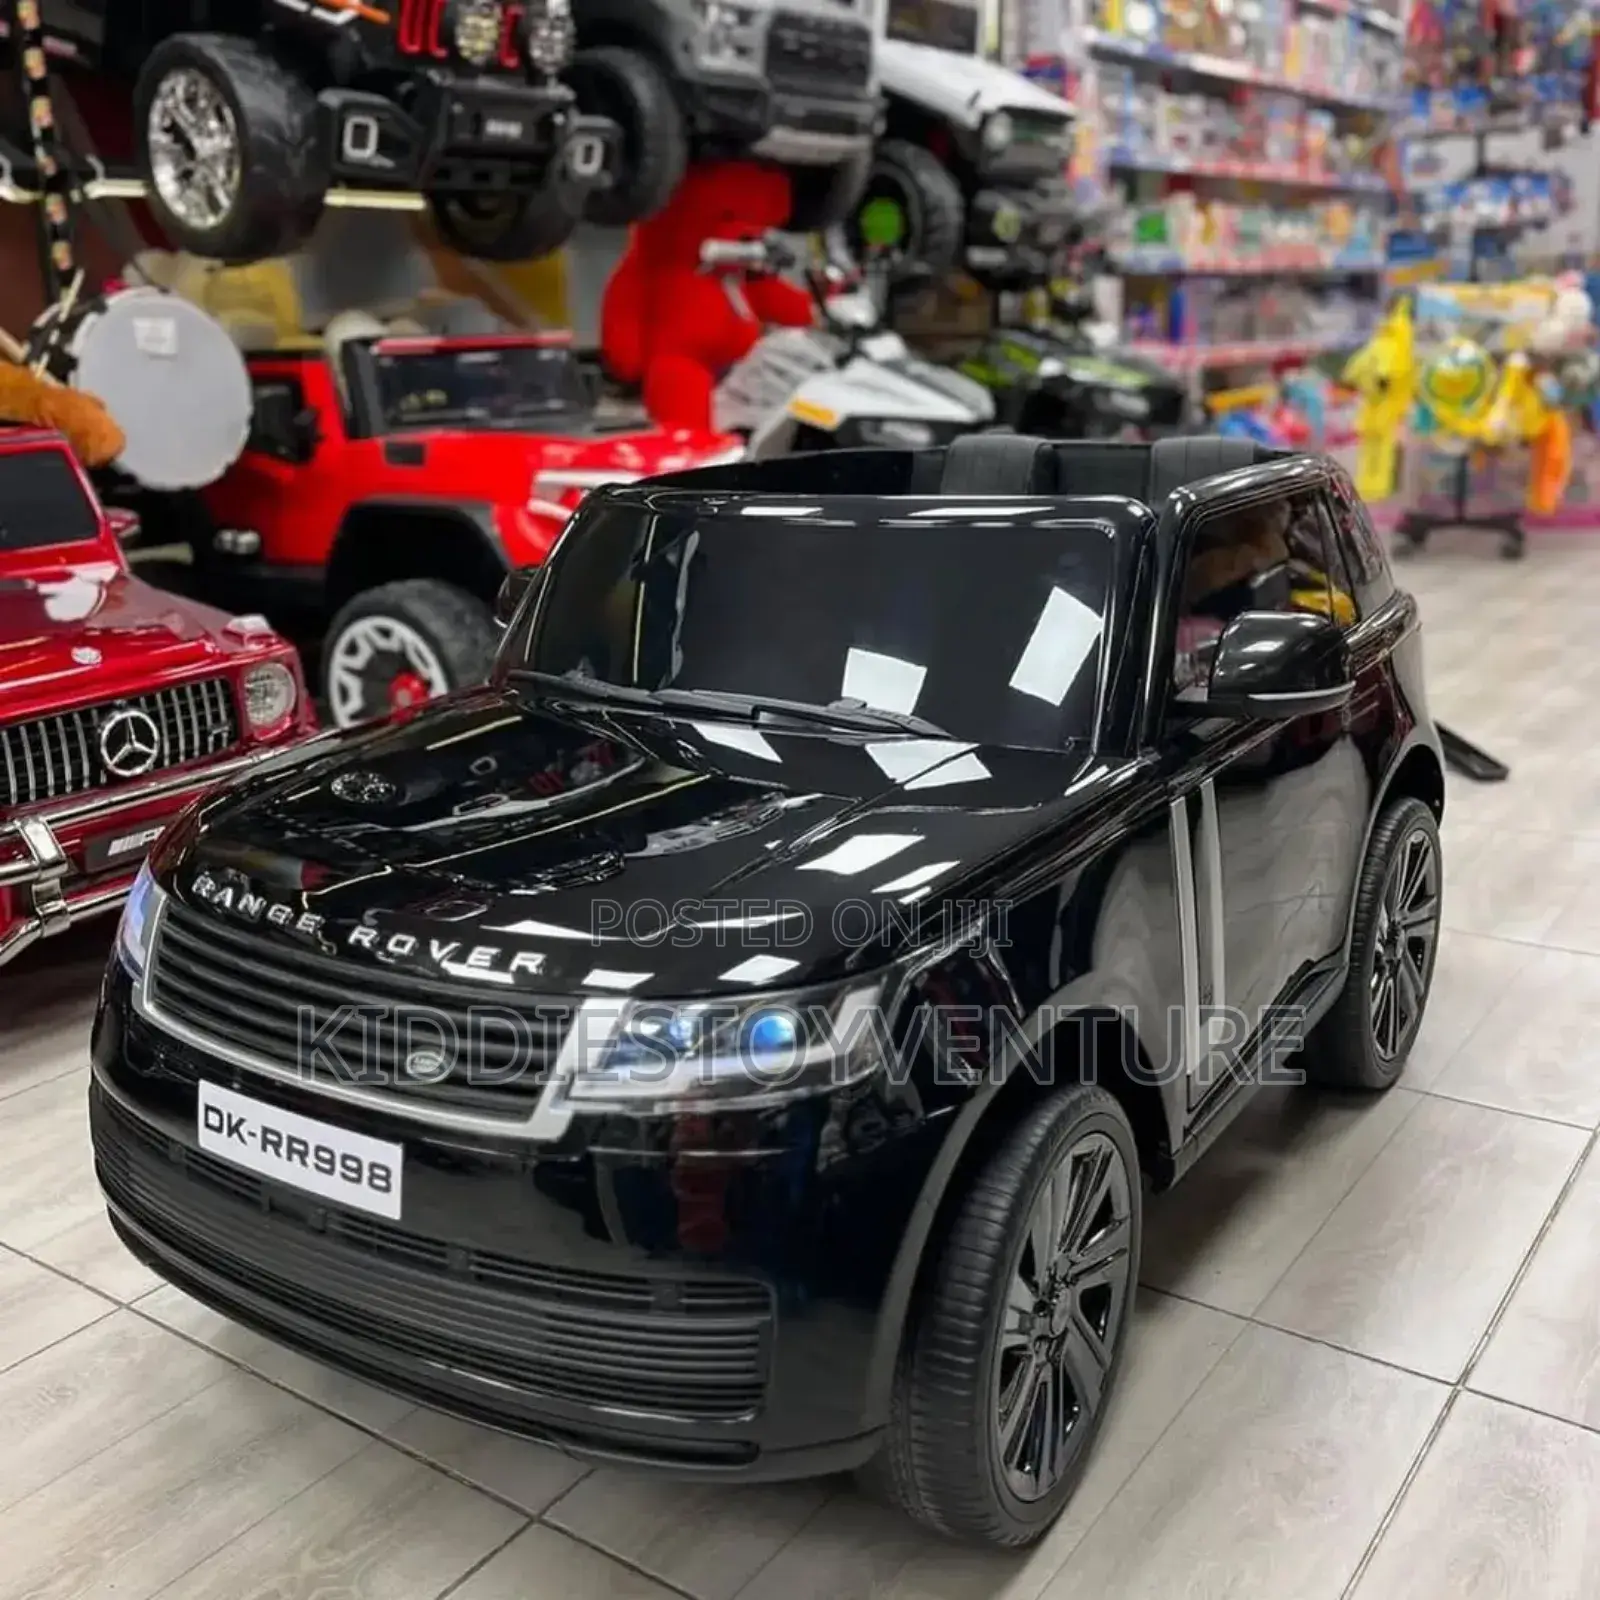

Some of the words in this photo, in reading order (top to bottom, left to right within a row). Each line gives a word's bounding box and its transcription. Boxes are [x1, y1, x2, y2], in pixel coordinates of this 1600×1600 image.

[192, 875, 324, 934] RANGE
[349, 924, 546, 975] ROVER
[203, 1103, 393, 1194] DK-RR998
